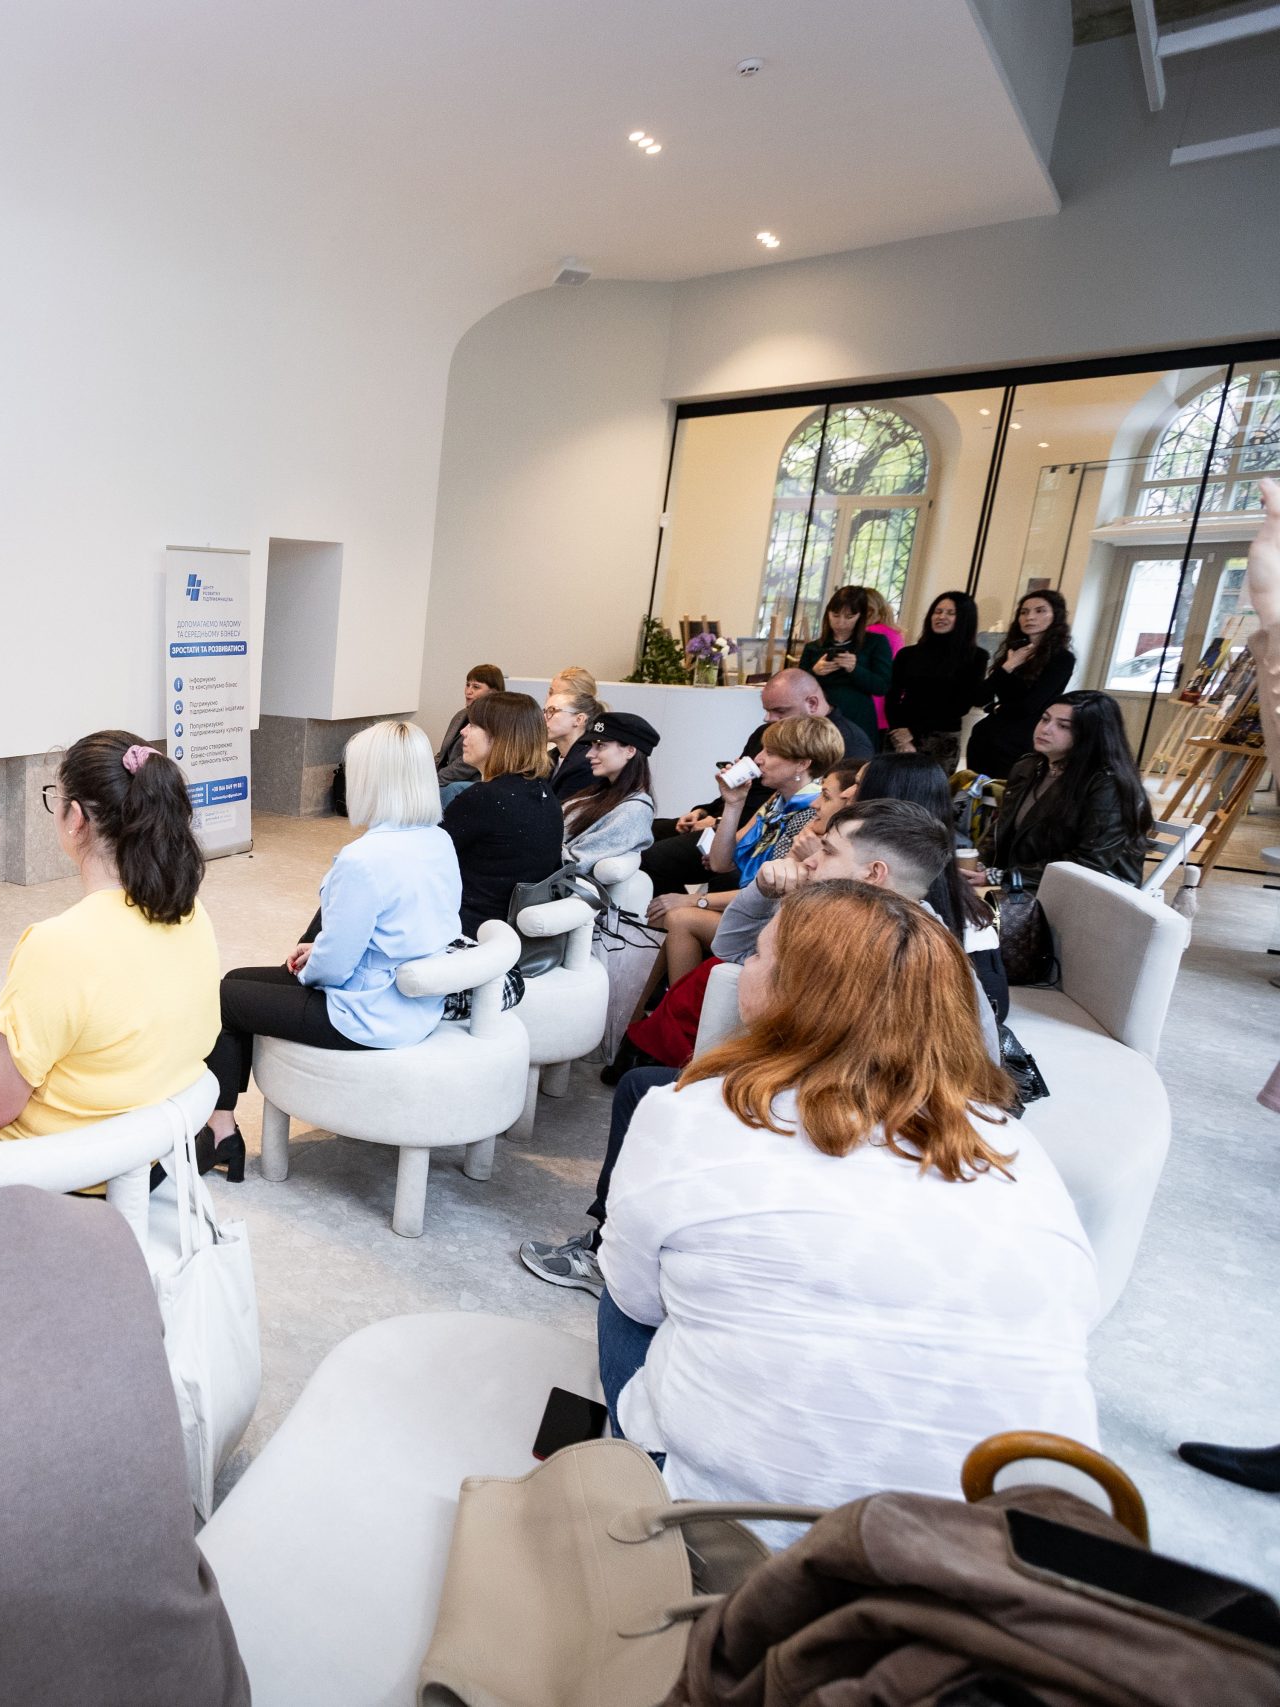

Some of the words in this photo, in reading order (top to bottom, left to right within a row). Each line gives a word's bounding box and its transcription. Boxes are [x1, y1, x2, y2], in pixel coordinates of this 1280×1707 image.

[177, 620, 219, 629] ДОПОМАГАЄМО
[219, 620, 241, 628] МАЛОМУ
[177, 630, 184, 638] ТА
[184, 630, 220, 638] СЕРЕДНЬОМУ
[220, 629, 241, 637] БІЗНЕСУ
[171, 646, 200, 654] ЗРОСТАТИ
[208, 644, 245, 653] РОЗВИВАТИСЯ
